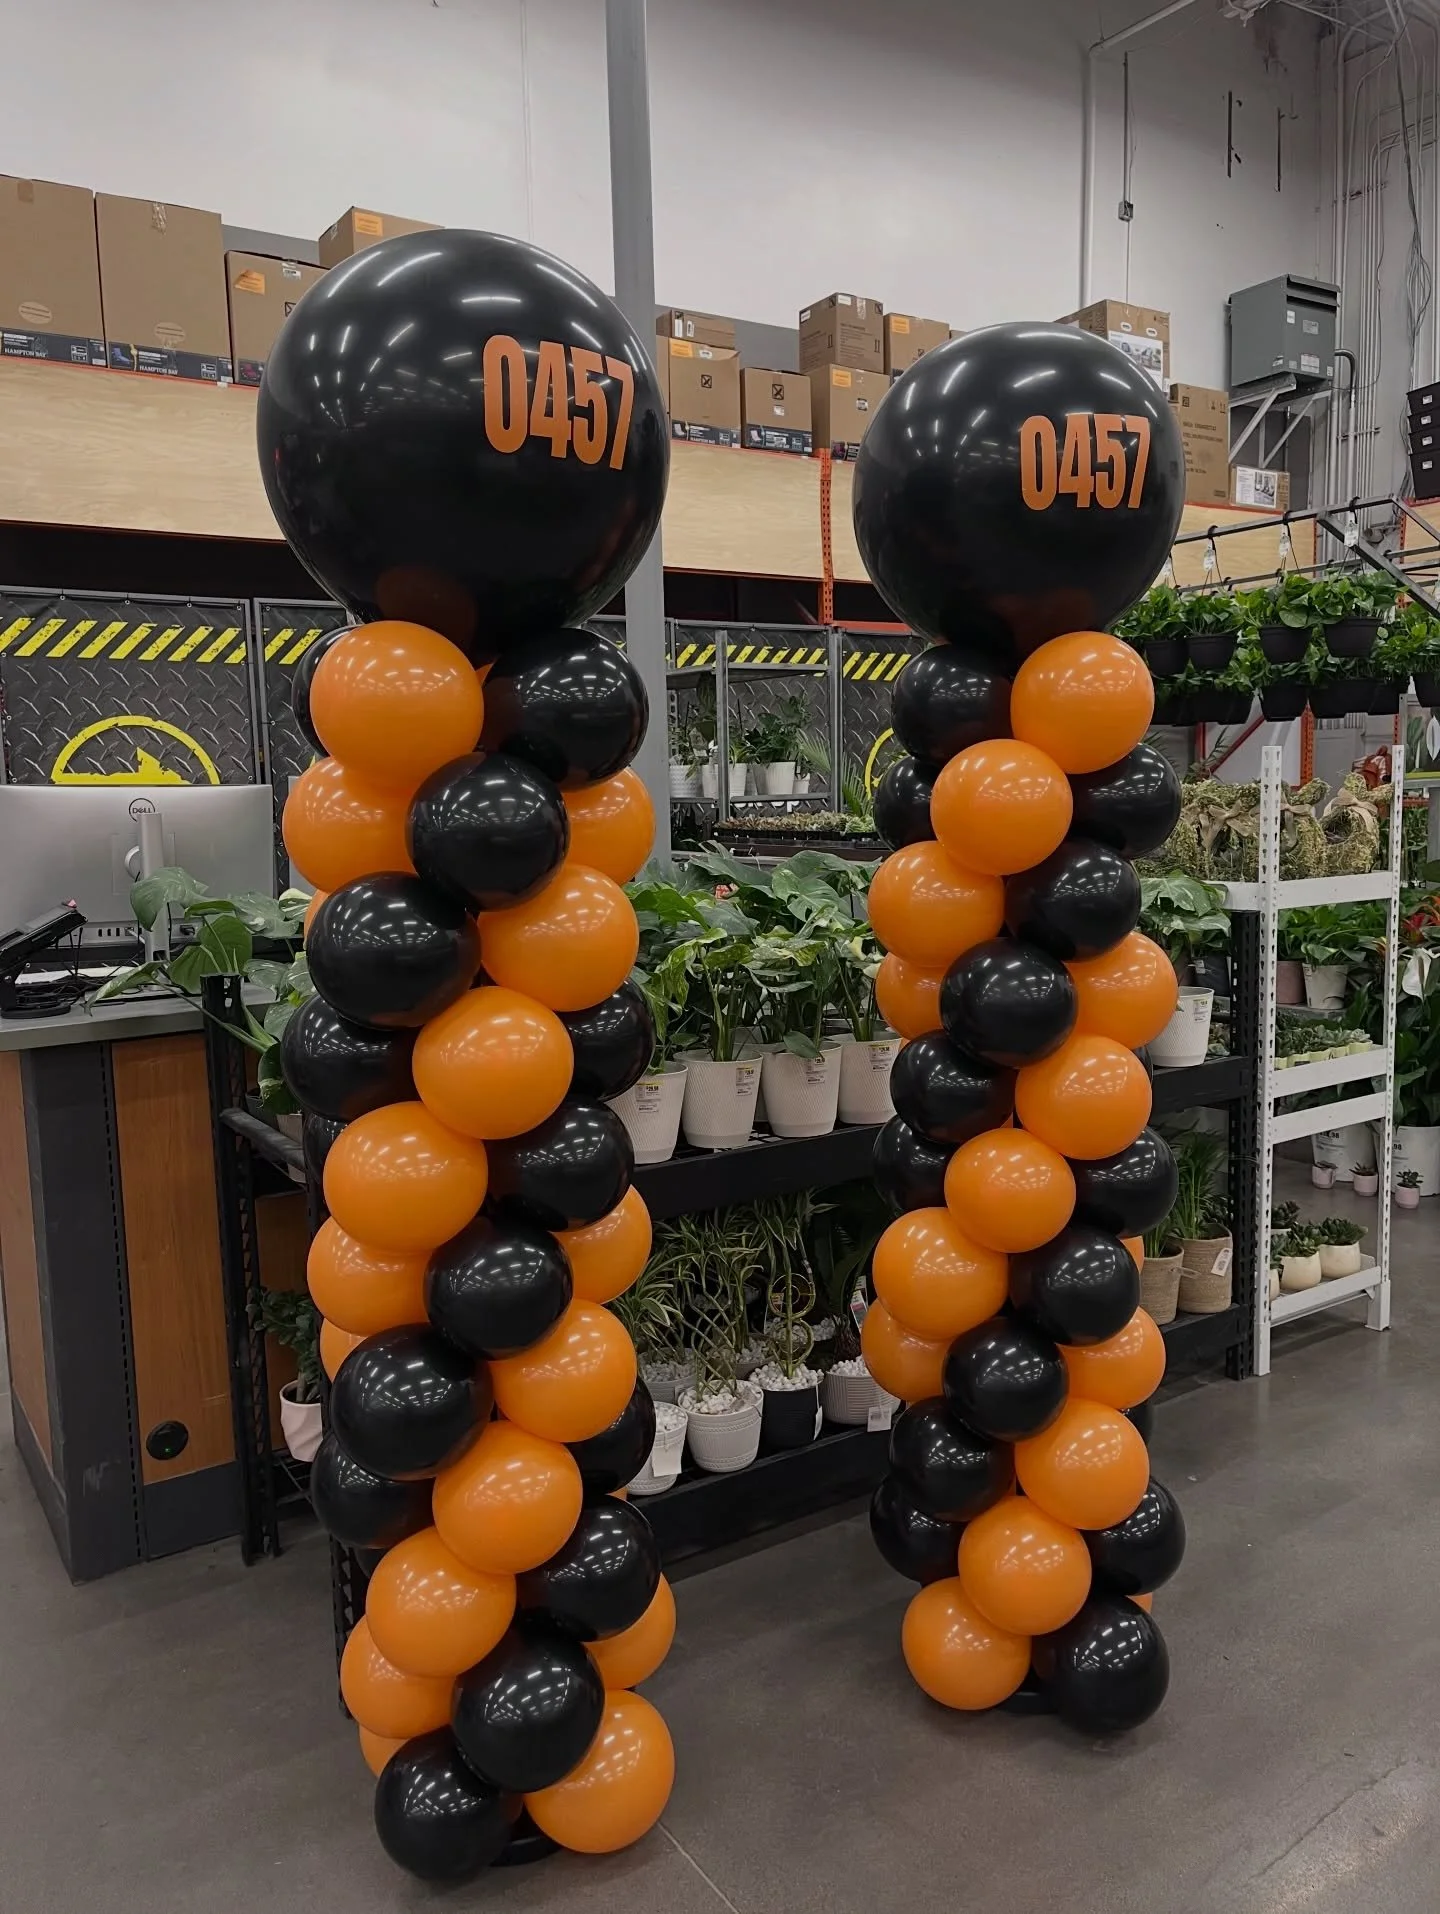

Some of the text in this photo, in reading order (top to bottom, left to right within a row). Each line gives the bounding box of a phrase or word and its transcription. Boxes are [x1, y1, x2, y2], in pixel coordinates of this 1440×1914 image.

[4, 347, 35, 357] HAMPTON
[139, 365, 178, 376] HAMPTON BAY
[483, 334, 634, 470] 0457
[1020, 413, 1151, 511] 0457
